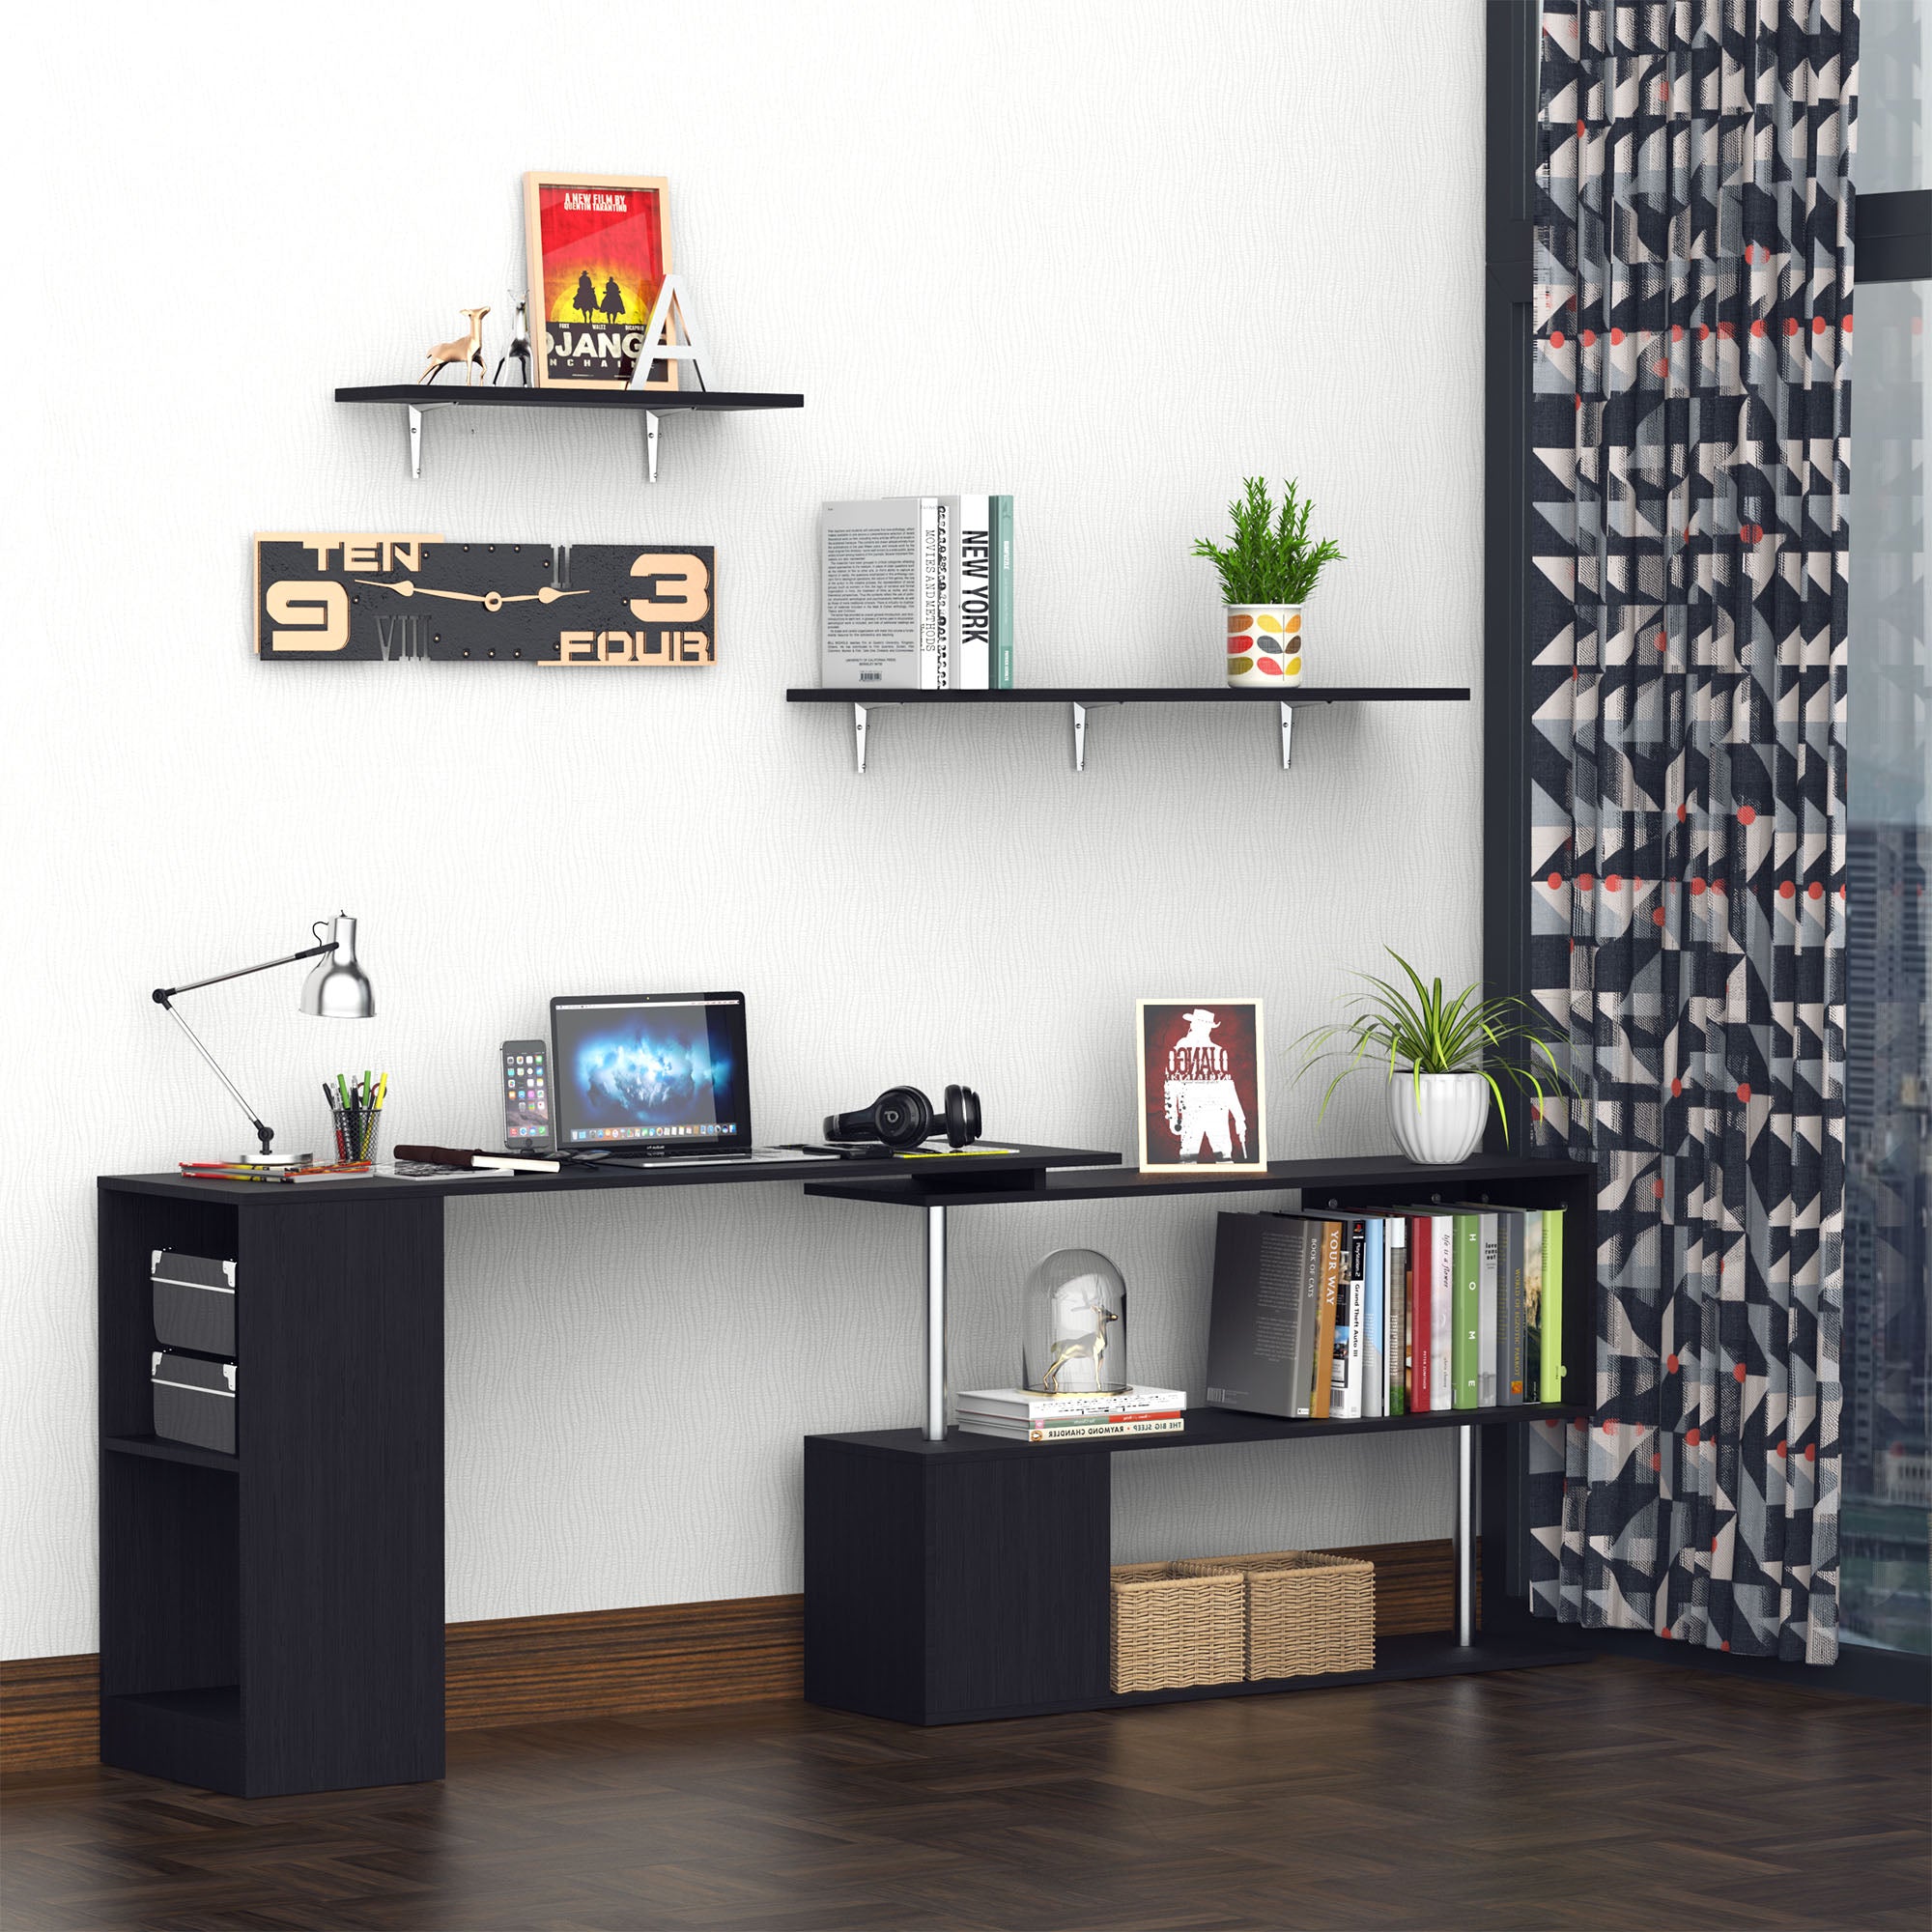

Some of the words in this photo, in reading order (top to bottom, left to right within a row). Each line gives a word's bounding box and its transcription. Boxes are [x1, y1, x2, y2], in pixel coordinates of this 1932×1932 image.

[564, 202, 591, 211] QUENTIN
[592, 203, 627, 213] TARANTINO
[565, 193, 571, 203] A
[572, 193, 591, 204] NEW
[593, 194, 612, 204] FILM
[614, 195, 625, 205] BY
[546, 331, 645, 358] JANG
[303, 542, 421, 571] TEN
[925, 529, 935, 574] MOVIES
[962, 531, 988, 579] NEW
[630, 554, 710, 622] 3
[925, 575, 935, 598] AND
[267, 581, 350, 651] 9
[925, 601, 935, 652] METHODS
[961, 585, 989, 644] YORK
[560, 631, 710, 662] FOUR
[1328, 1230, 1339, 1270] YOUR
[1309, 1264, 1316, 1275] OF
[1326, 1275, 1338, 1305] WAY
